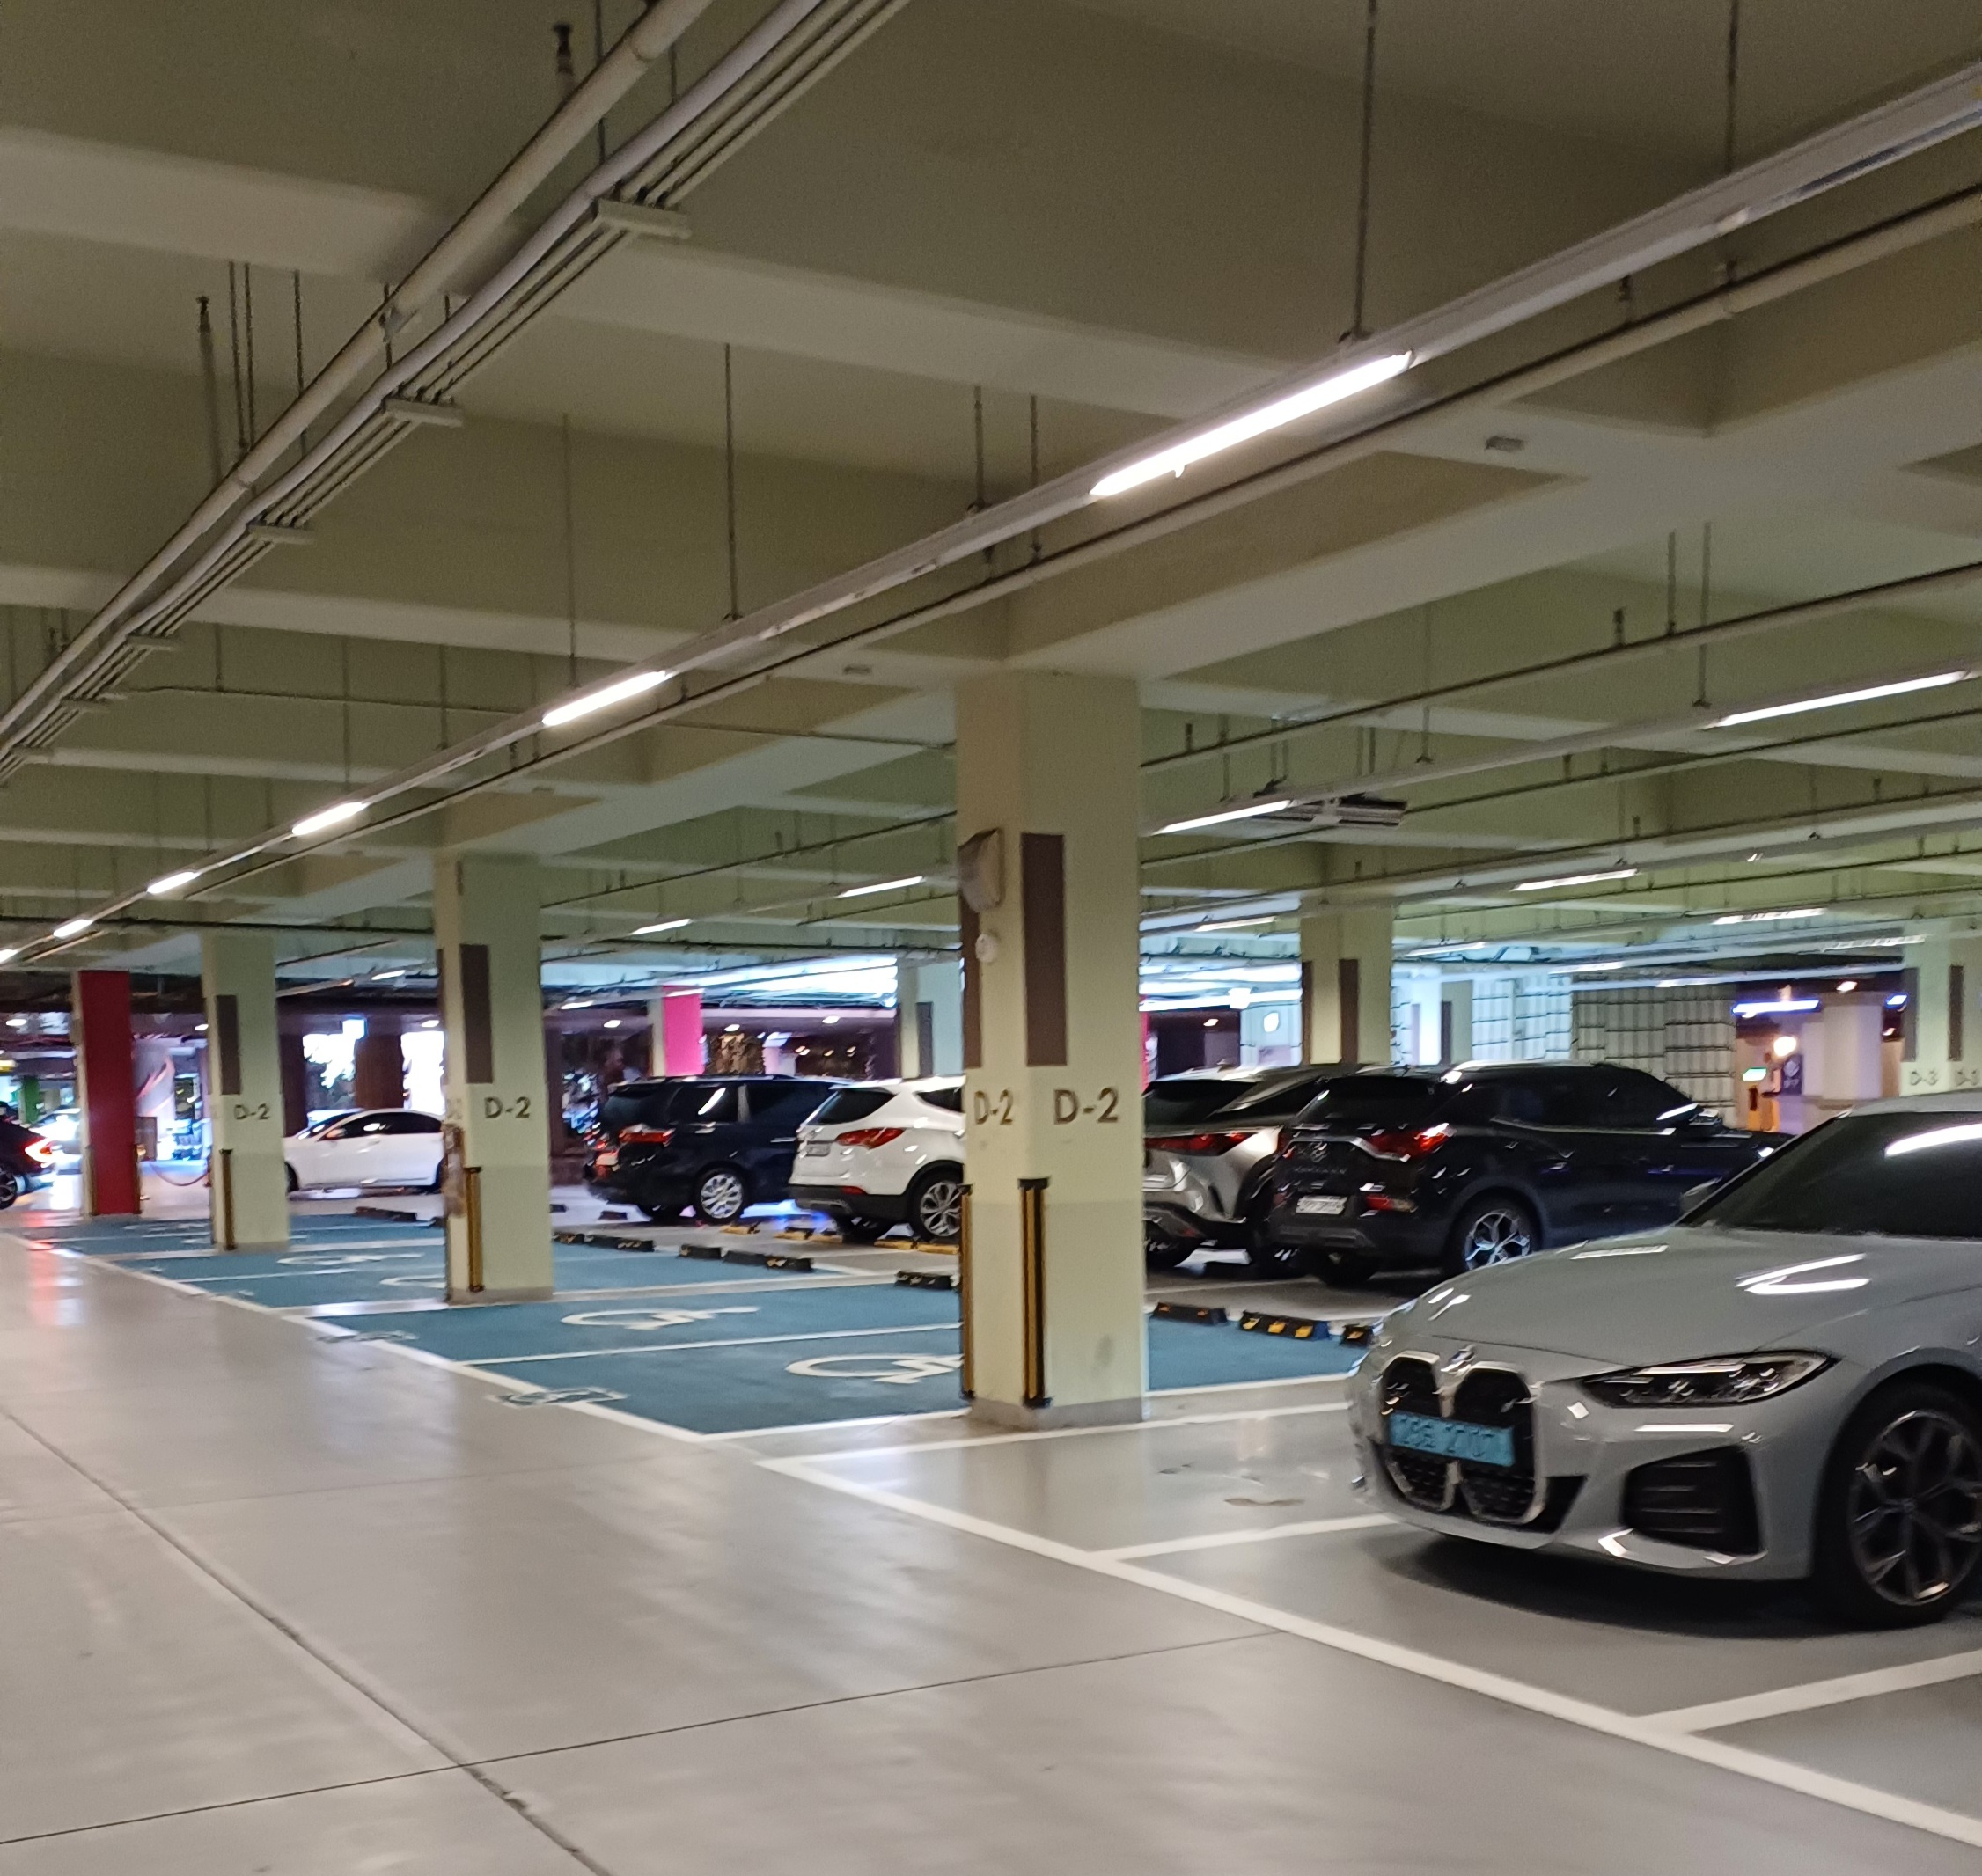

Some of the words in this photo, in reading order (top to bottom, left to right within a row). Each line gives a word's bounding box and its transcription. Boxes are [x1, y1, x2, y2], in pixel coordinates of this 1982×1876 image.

[233, 1103, 271, 1120] D-2
[484, 1096, 531, 1118] D-2
[974, 1089, 1013, 1125] D-2
[1054, 1087, 1119, 1125] D-2
